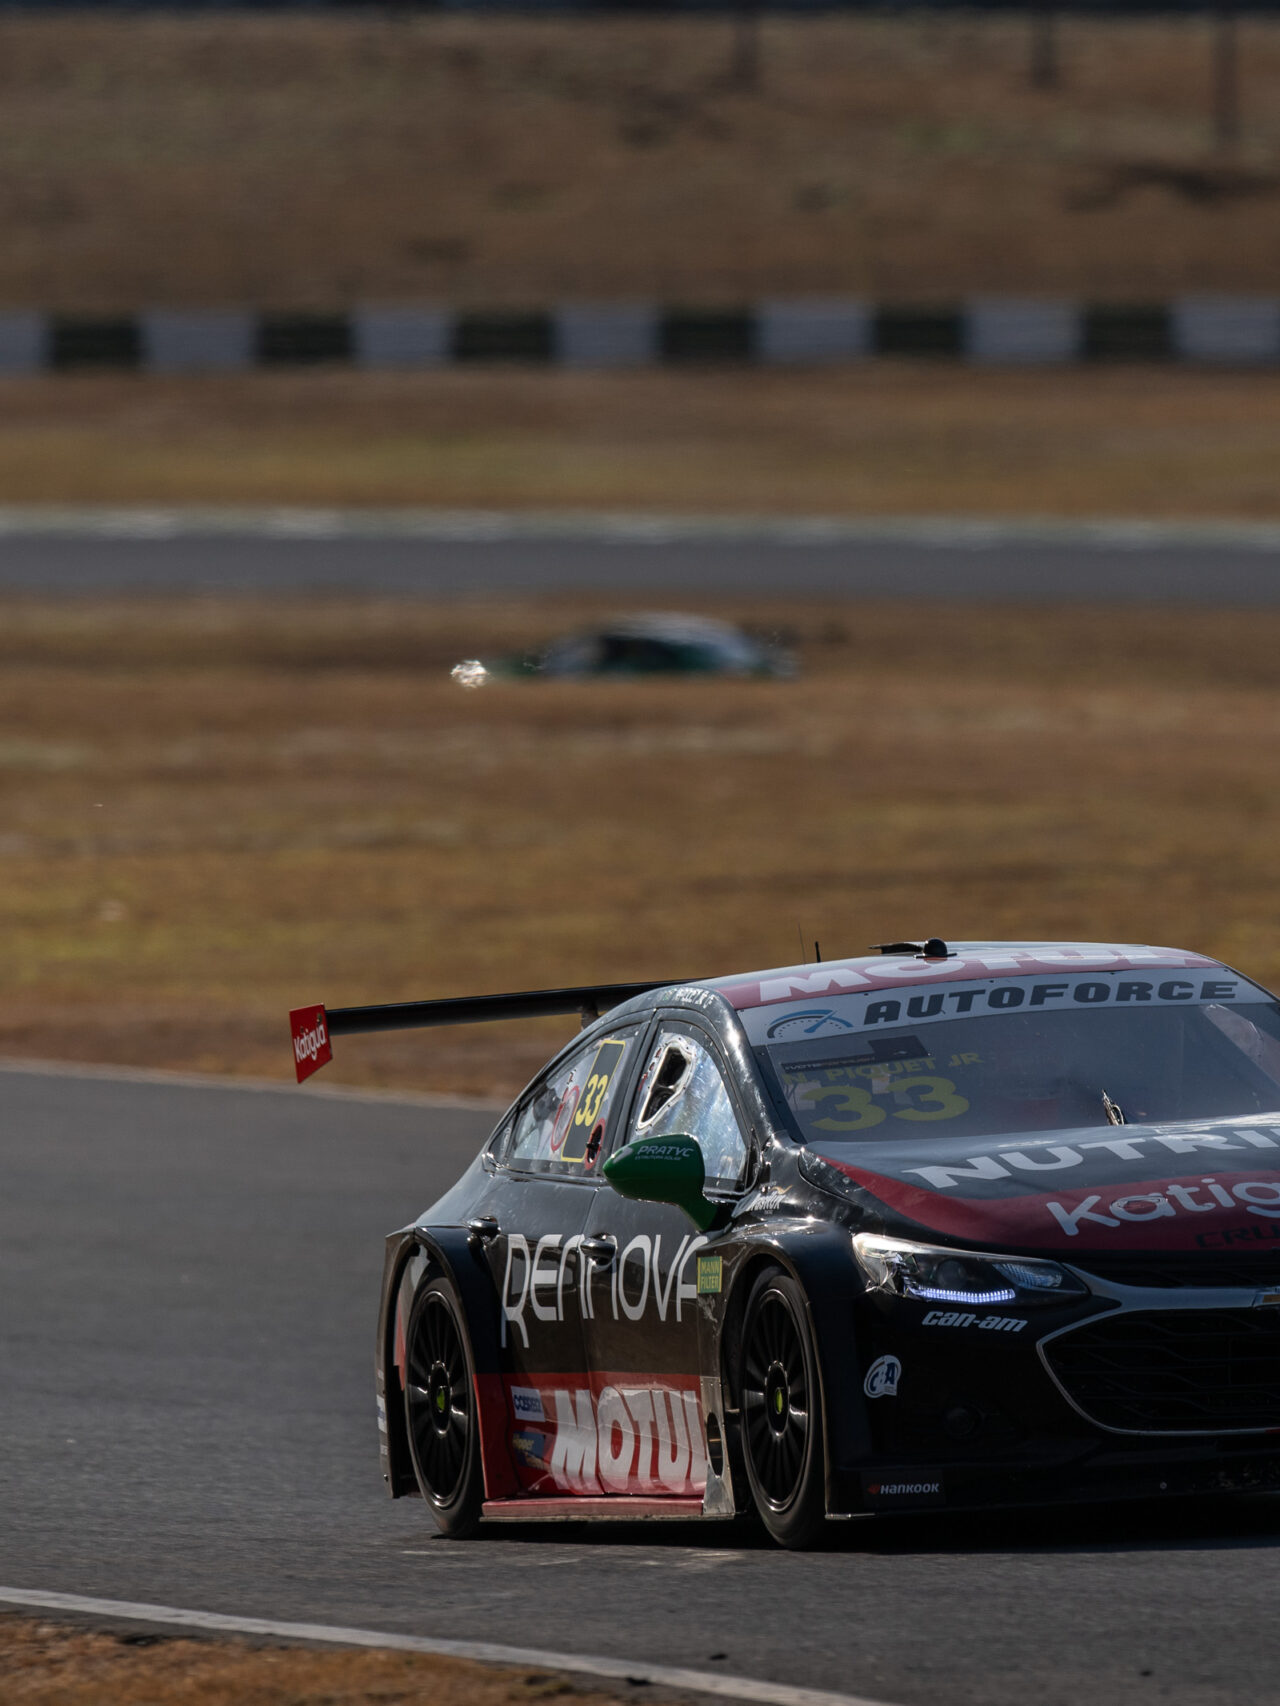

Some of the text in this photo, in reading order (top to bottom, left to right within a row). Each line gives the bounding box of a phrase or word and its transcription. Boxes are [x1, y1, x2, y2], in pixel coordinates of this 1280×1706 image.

[864, 981, 1238, 1025] AUTOFORCE
[294, 1024, 327, 1064] Katigua
[826, 1057, 936, 1081] PIQUET
[948, 1053, 985, 1067] JR
[574, 1074, 608, 1127] 33
[802, 1076, 970, 1132] 33
[637, 1145, 694, 1157] PRATYC
[551, 1386, 708, 1494] MOTUL
